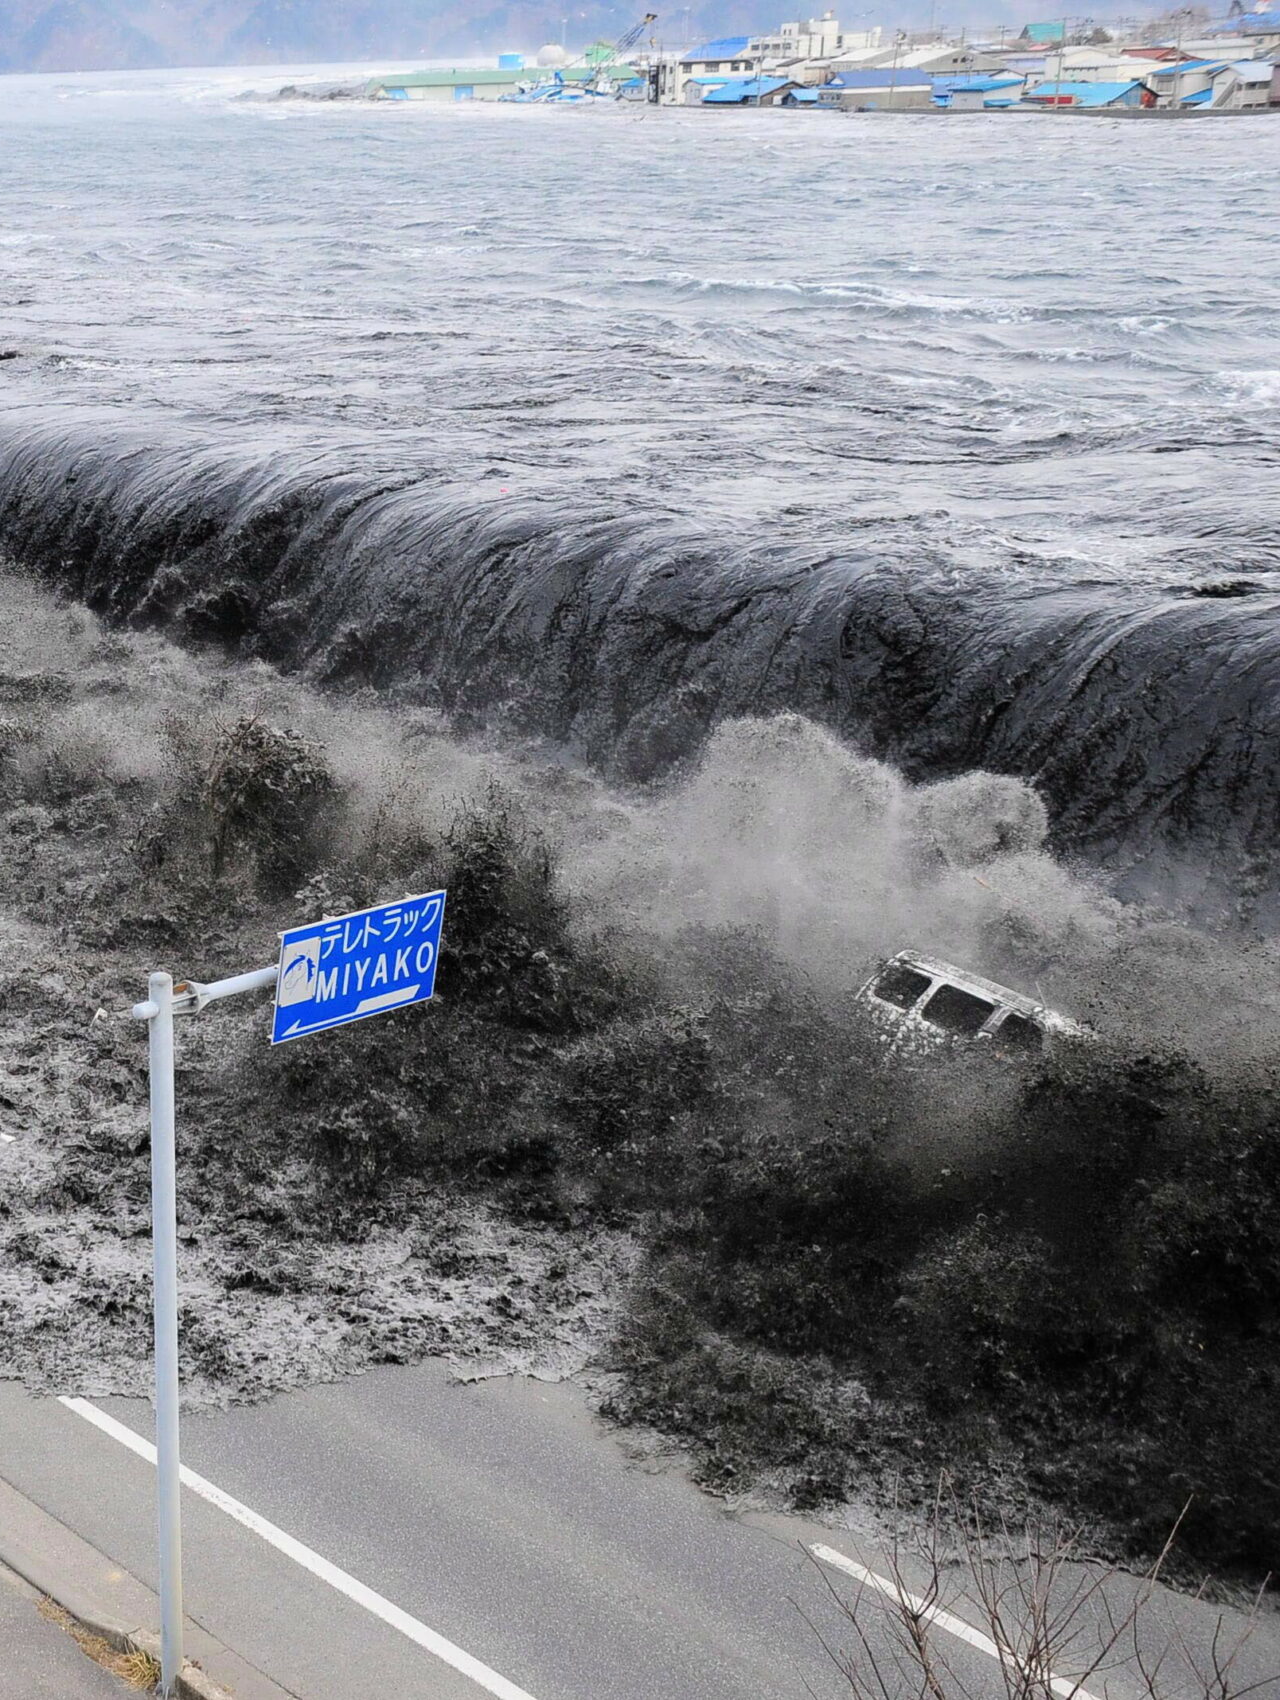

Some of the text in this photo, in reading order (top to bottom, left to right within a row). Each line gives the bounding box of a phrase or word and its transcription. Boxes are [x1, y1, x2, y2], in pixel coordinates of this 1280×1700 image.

[321, 898, 442, 959] テレトラック
[315, 941, 434, 1004] MIYAKO
